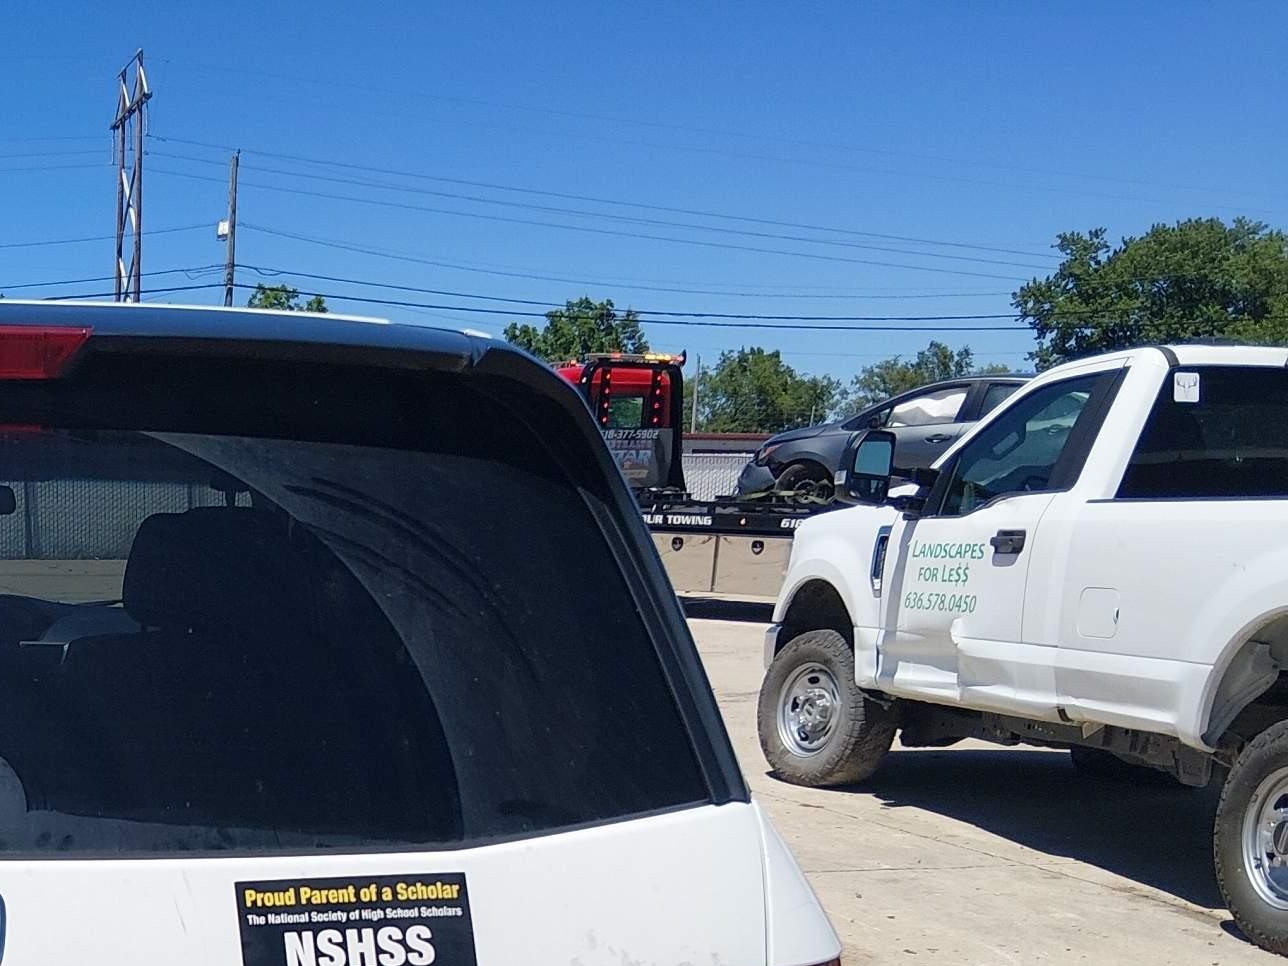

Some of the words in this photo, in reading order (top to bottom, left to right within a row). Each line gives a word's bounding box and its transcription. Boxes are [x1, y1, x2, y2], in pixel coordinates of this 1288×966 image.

[667, 515, 712, 526] TOWING
[904, 591, 977, 614] 636.578.0450
[245, 889, 296, 908] Proud
[300, 885, 357, 905] Parent
[360, 884, 378, 902] of
[381, 886, 394, 901] a
[396, 881, 460, 901] Scholar
[247, 914, 266, 925] The
[268, 911, 309, 924] National
[311, 908, 347, 923] Society
[349, 908, 360, 920] of
[361, 907, 385, 920] High
[386, 906, 419, 919] School
[421, 905, 463, 917] Scholars
